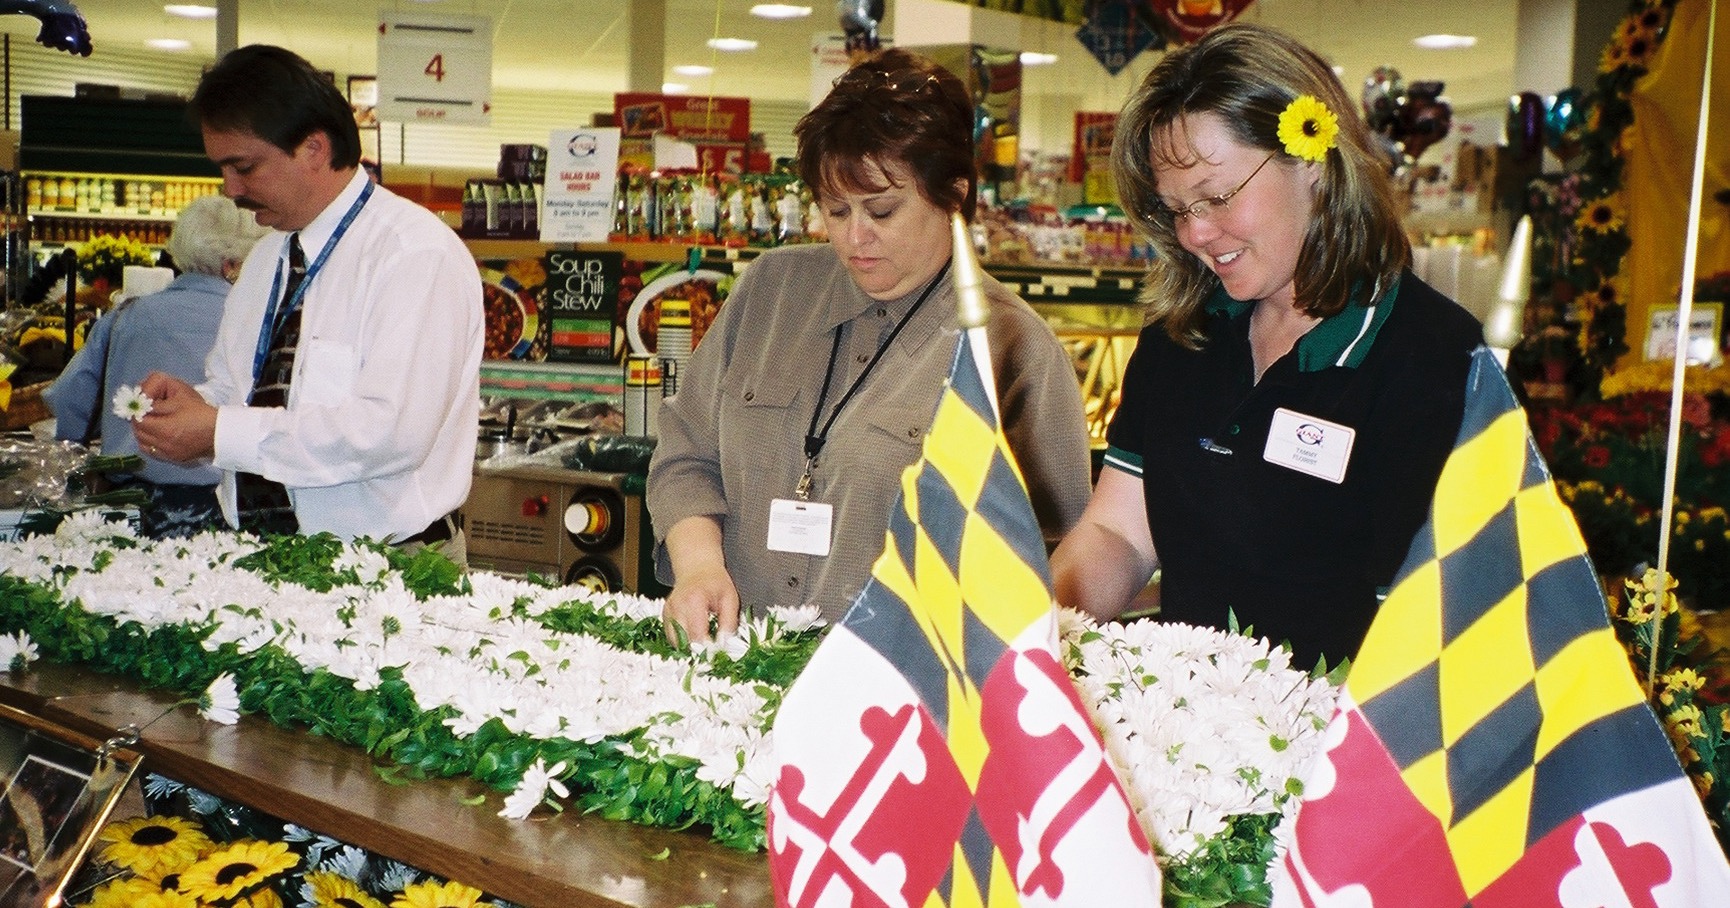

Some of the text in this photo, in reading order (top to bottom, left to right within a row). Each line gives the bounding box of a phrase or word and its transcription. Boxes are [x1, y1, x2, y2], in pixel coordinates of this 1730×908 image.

[424, 53, 446, 82] 4
[560, 172, 600, 181] SALAD BAR
[566, 183, 591, 191] HOURS
[550, 254, 603, 280] Soup
[566, 274, 605, 294] Chili
[553, 289, 603, 310] Stew
